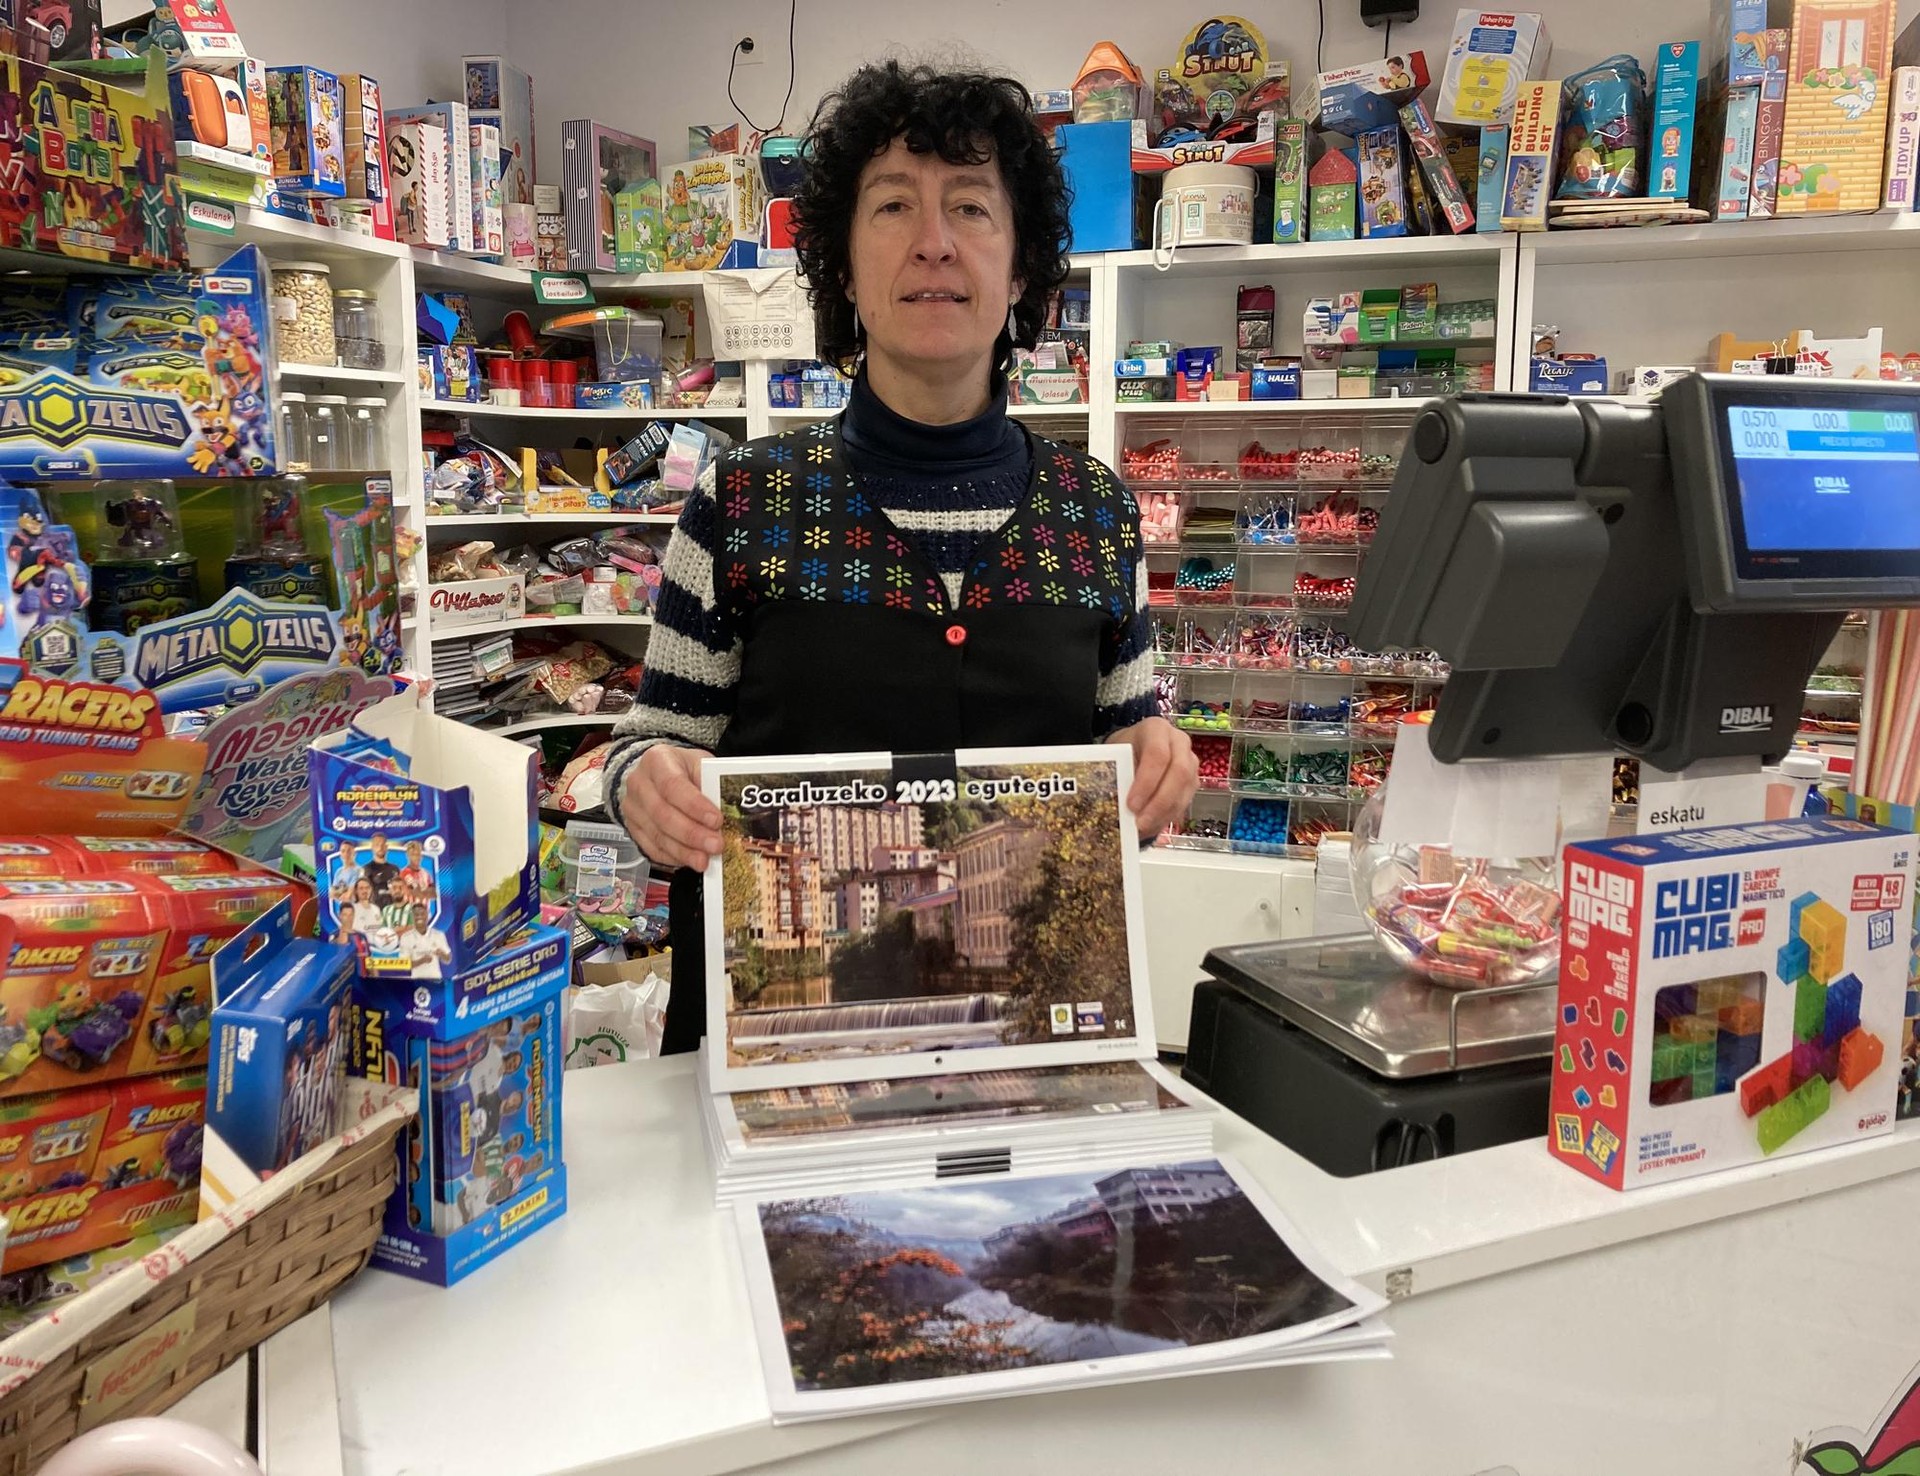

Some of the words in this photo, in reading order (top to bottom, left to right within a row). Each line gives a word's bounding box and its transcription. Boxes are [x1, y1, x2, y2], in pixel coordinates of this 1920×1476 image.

[1480, 15, 1514, 25] Fisher-Price
[1184, 50, 1255, 77] STNUT
[1323, 69, 1362, 82] Fisher-Price
[37, 85, 123, 146] ALPHA
[1511, 99, 1528, 152] CASTLE
[1525, 86, 1544, 152] BUILDING
[1540, 124, 1553, 152] SET
[1758, 104, 1773, 159] BINGOA
[1900, 126, 1911, 142] UP
[1173, 145, 1225, 166] STNUT
[1896, 147, 1910, 175] TIDY
[190, 205, 234, 222] Eskulanak
[542, 279, 582, 288] Egurrezko
[1400, 321, 1426, 331] Trident
[1117, 362, 1143, 373] Orbit
[581, 386, 613, 398] Magic
[1813, 477, 1850, 488] DIBAL
[595, 499, 610, 507] SAL
[138, 626, 219, 682] META
[1, 680, 155, 733] RACERS
[1720, 705, 1774, 726] DIBAL
[0, 726, 31, 744] RBO
[32, 728, 91, 747] TUNING
[90, 733, 142, 751] TEAMS
[235, 745, 309, 783] Wate
[61, 774, 84, 787] MIX
[91, 776, 125, 789] RACE
[741, 780, 888, 809] Soraluzeko
[895, 779, 958, 804] 2023
[966, 774, 1078, 803] egutegia
[336, 790, 419, 802] ADRENALYN
[347, 819, 374, 830] LaLiga
[385, 819, 426, 829] Santander
[1650, 804, 1706, 826] eskatu
[581, 855, 615, 865] Dentaduras
[1570, 861, 1636, 909] CUBI
[1655, 872, 1740, 919] CUBI
[1753, 868, 1781, 881] ROMPE
[1742, 879, 1779, 893] CABEZAS
[1884, 880, 1901, 897] 48
[1740, 919, 1763, 936] PRO
[1870, 919, 1892, 941] 180
[376, 958, 411, 967] PANINI
[463, 971, 492, 993] BOX
[492, 953, 532, 981] SERIE
[532, 943, 559, 964] ORO
[454, 995, 470, 1020] 4
[531, 1038, 543, 1144] ADRENALYN
[1559, 1123, 1580, 1142] 180
[1638, 1159, 1664, 1174] ¿ESTÁS
[1664, 1148, 1707, 1168] PREPARADO?
[1652, 1148, 1671, 1159] MODOS
[1671, 1146, 1680, 1155] DE
[1680, 1143, 1697, 1154] JUEGO
[513, 1190, 546, 1214] PANINI
